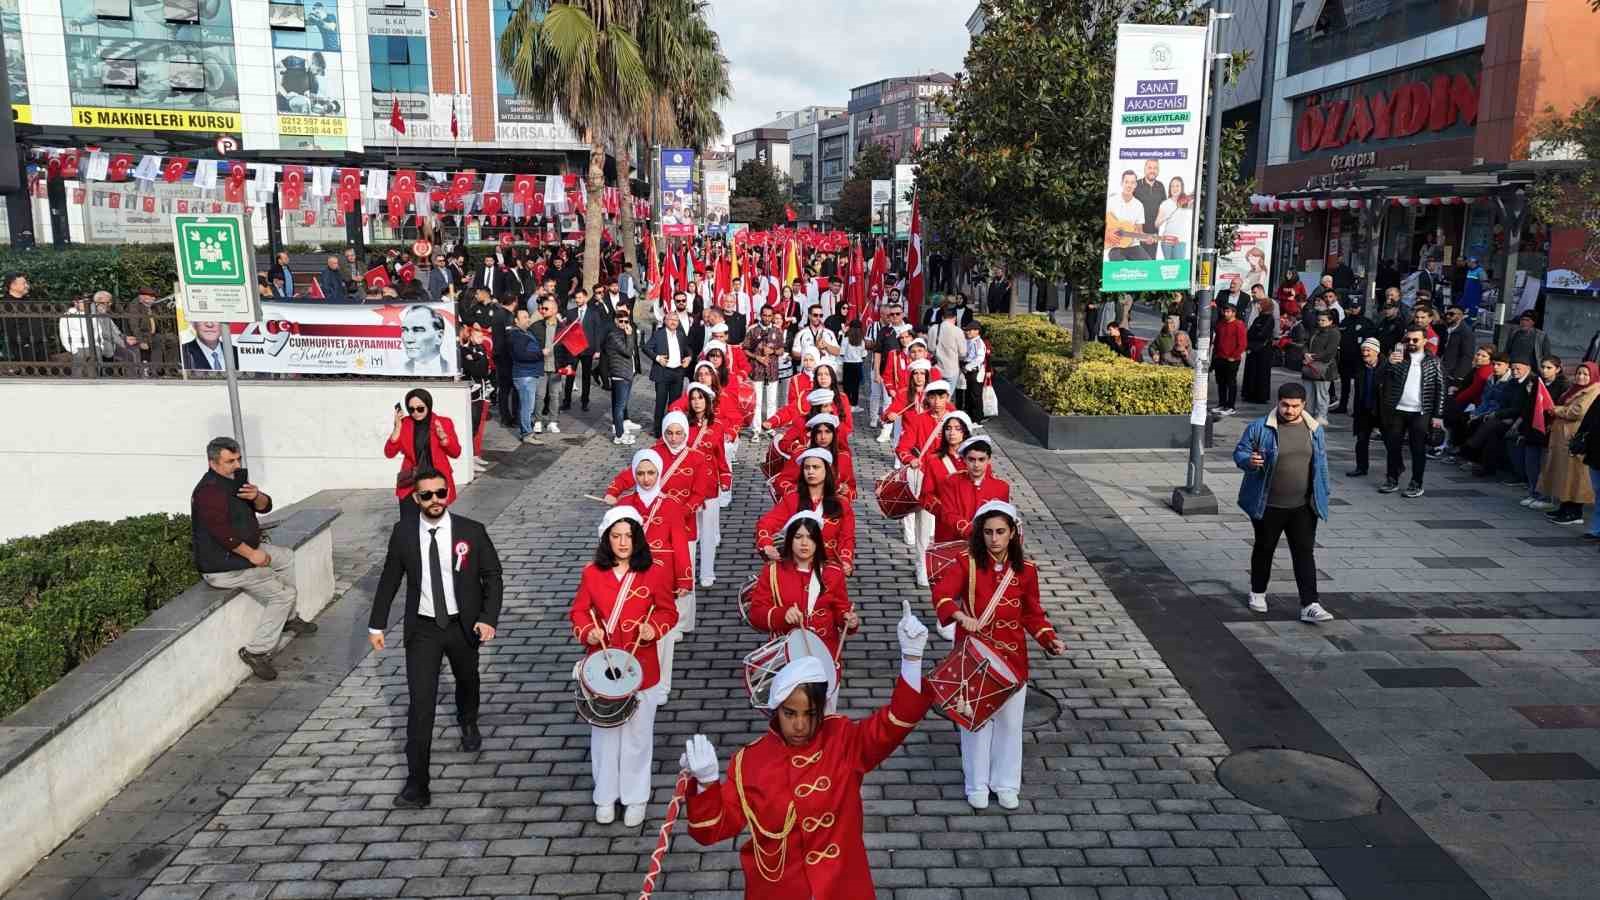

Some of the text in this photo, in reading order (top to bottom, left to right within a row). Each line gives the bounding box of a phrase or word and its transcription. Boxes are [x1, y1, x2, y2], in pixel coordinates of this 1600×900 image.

[1139, 82, 1176, 94] SANAT
[1126, 96, 1185, 111] AKADEMİSİ
[1297, 72, 1480, 153] ÖZAYDIN
[97, 112, 184, 127] MAKİNELERİ
[188, 115, 234, 129] KURSU
[281, 117, 301, 125] 0212
[1122, 115, 1144, 123] KURS
[1127, 128, 1153, 136] DEVAM
[289, 337, 402, 350] CUMHURİYET BAYRAMINIZ
[240, 346, 264, 355] EKİM
